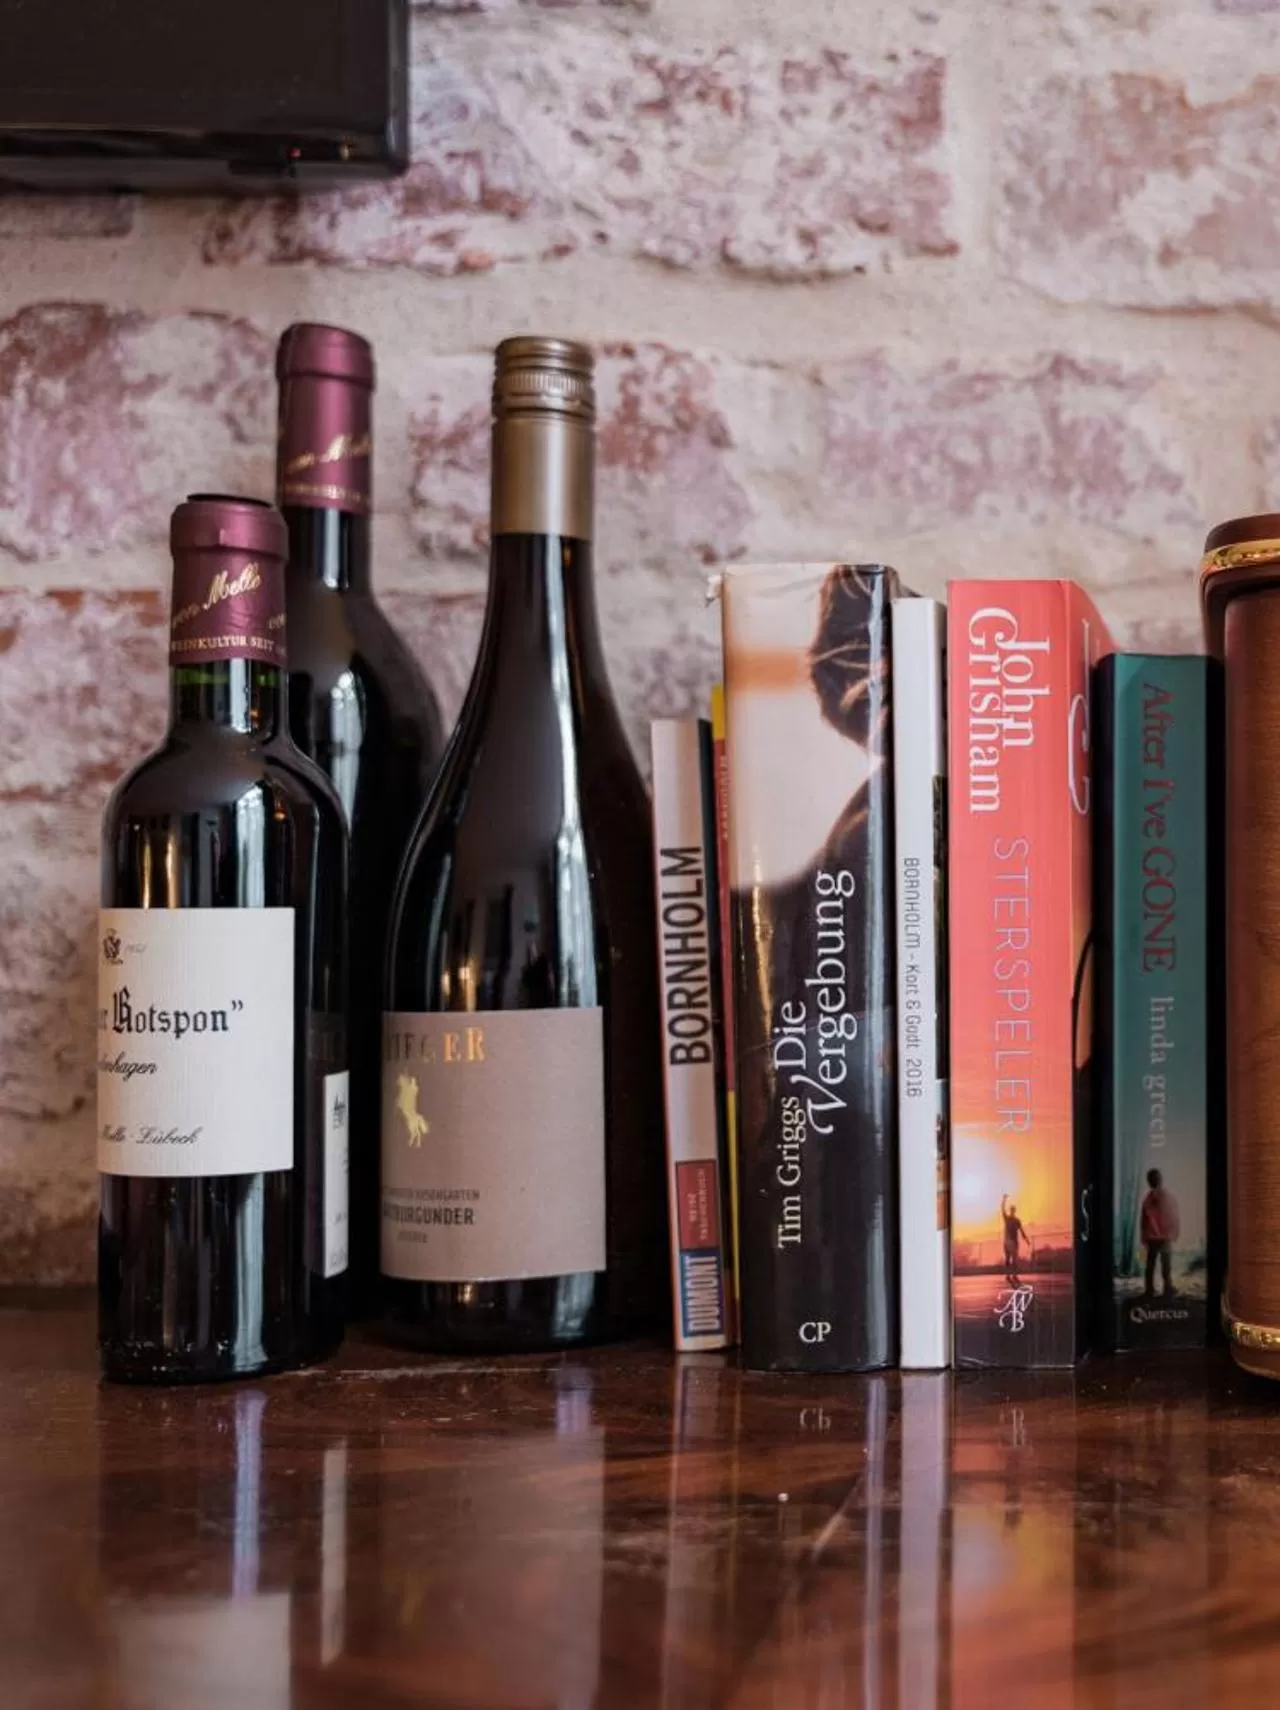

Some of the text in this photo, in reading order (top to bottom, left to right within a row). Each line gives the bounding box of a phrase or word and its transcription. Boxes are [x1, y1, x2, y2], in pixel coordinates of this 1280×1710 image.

[968, 606, 1018, 814] Grisham
[996, 633, 1050, 747] John
[1141, 683, 1177, 974] After I've GONE
[661, 846, 711, 1067] BORNHOLM
[791, 869, 856, 1135] Vergebung
[904, 963, 921, 996] Kort
[993, 837, 1034, 1133] STERSPELER
[774, 1001, 808, 1070] Die
[904, 1014, 922, 1050] Godt
[905, 1057, 922, 1098] 2016
[1142, 996, 1175, 1148] linda green
[777, 1094, 807, 1249] Tim Griggs
[683, 1255, 721, 1333] DUMONT
[799, 1321, 831, 1343] CP
[1129, 1307, 1189, 1323] Quercus
